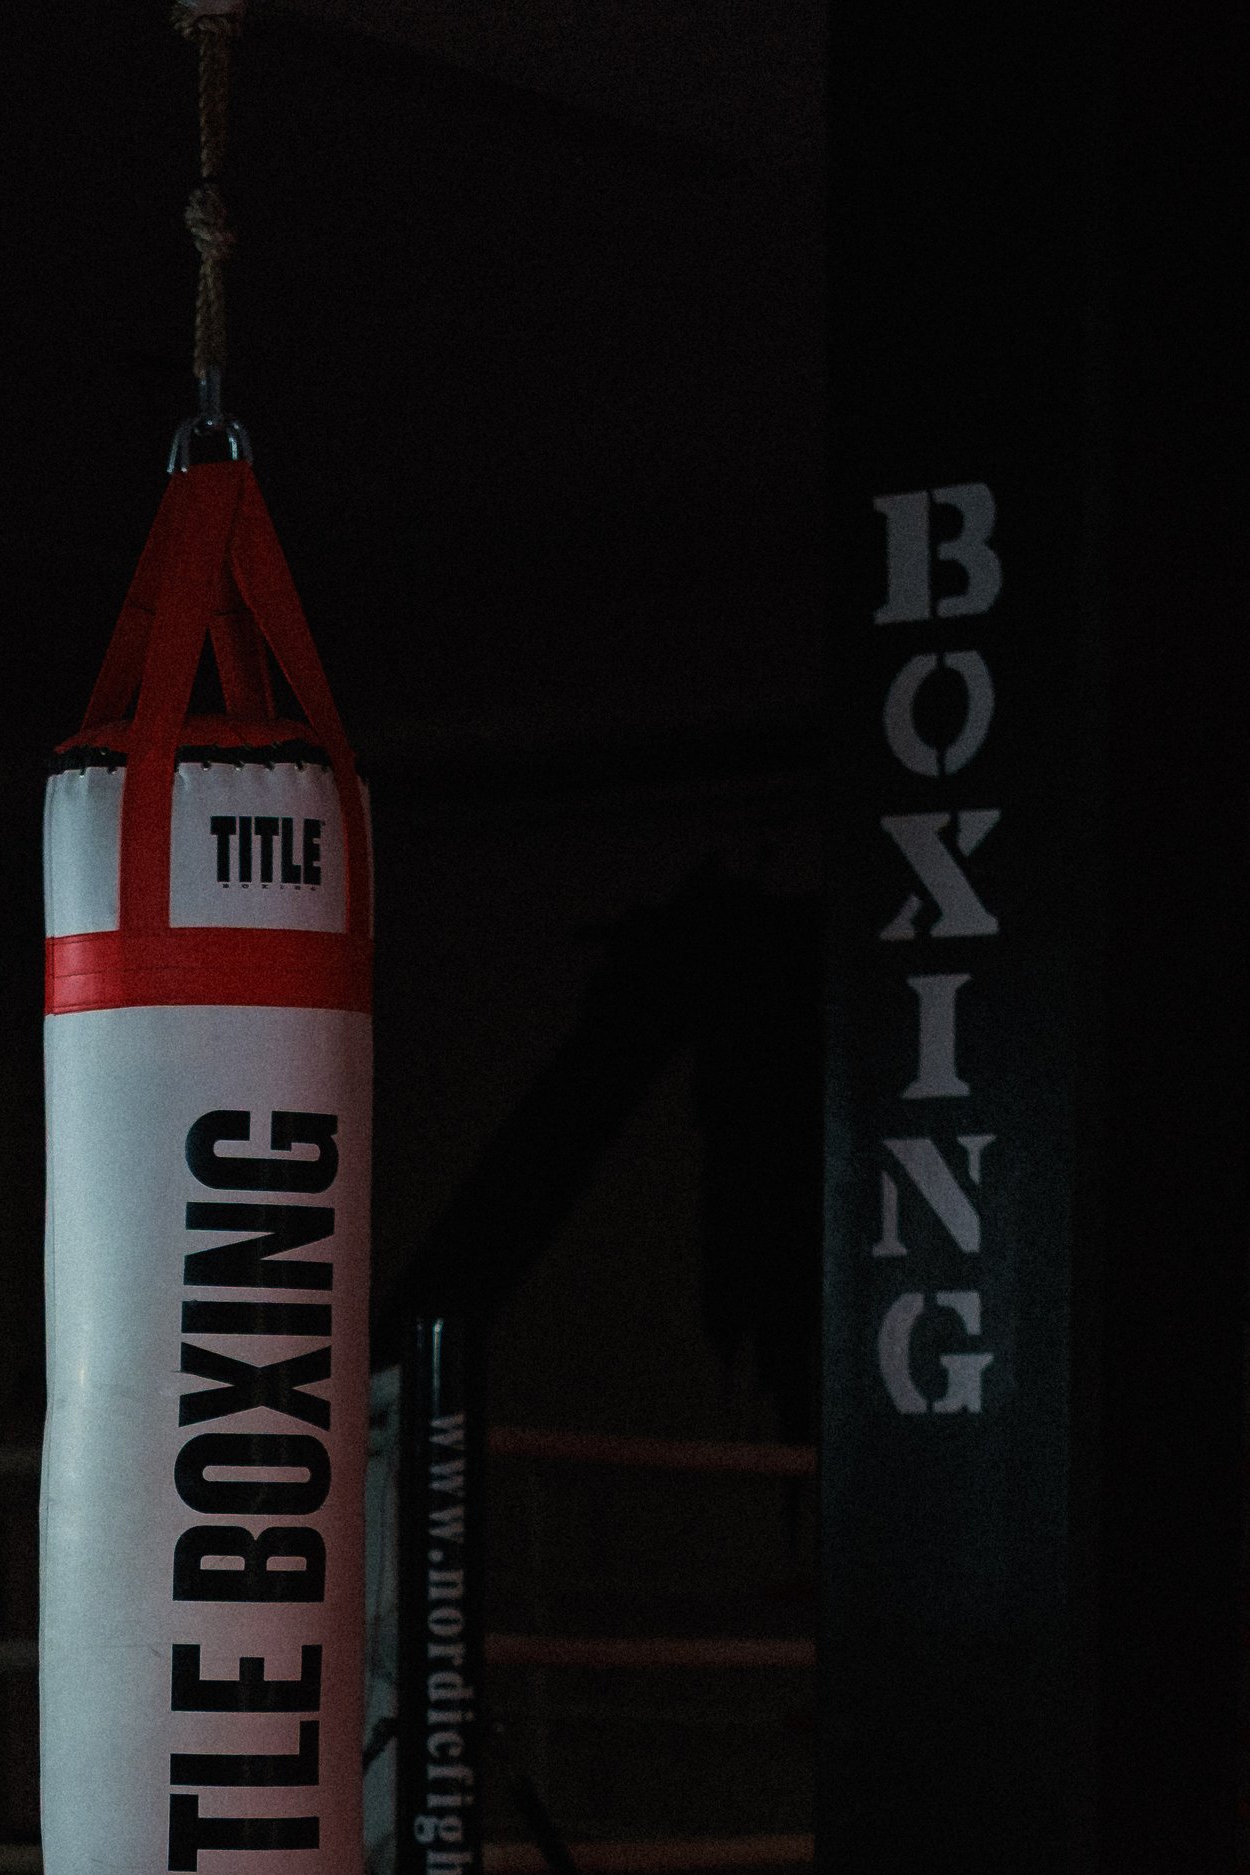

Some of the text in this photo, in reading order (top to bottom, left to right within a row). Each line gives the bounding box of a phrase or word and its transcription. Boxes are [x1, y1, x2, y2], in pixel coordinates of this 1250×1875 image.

[210, 816, 321, 885] TITLE
[872, 482, 1004, 1415] BOXING
[172, 1109, 340, 1602] BOXING
